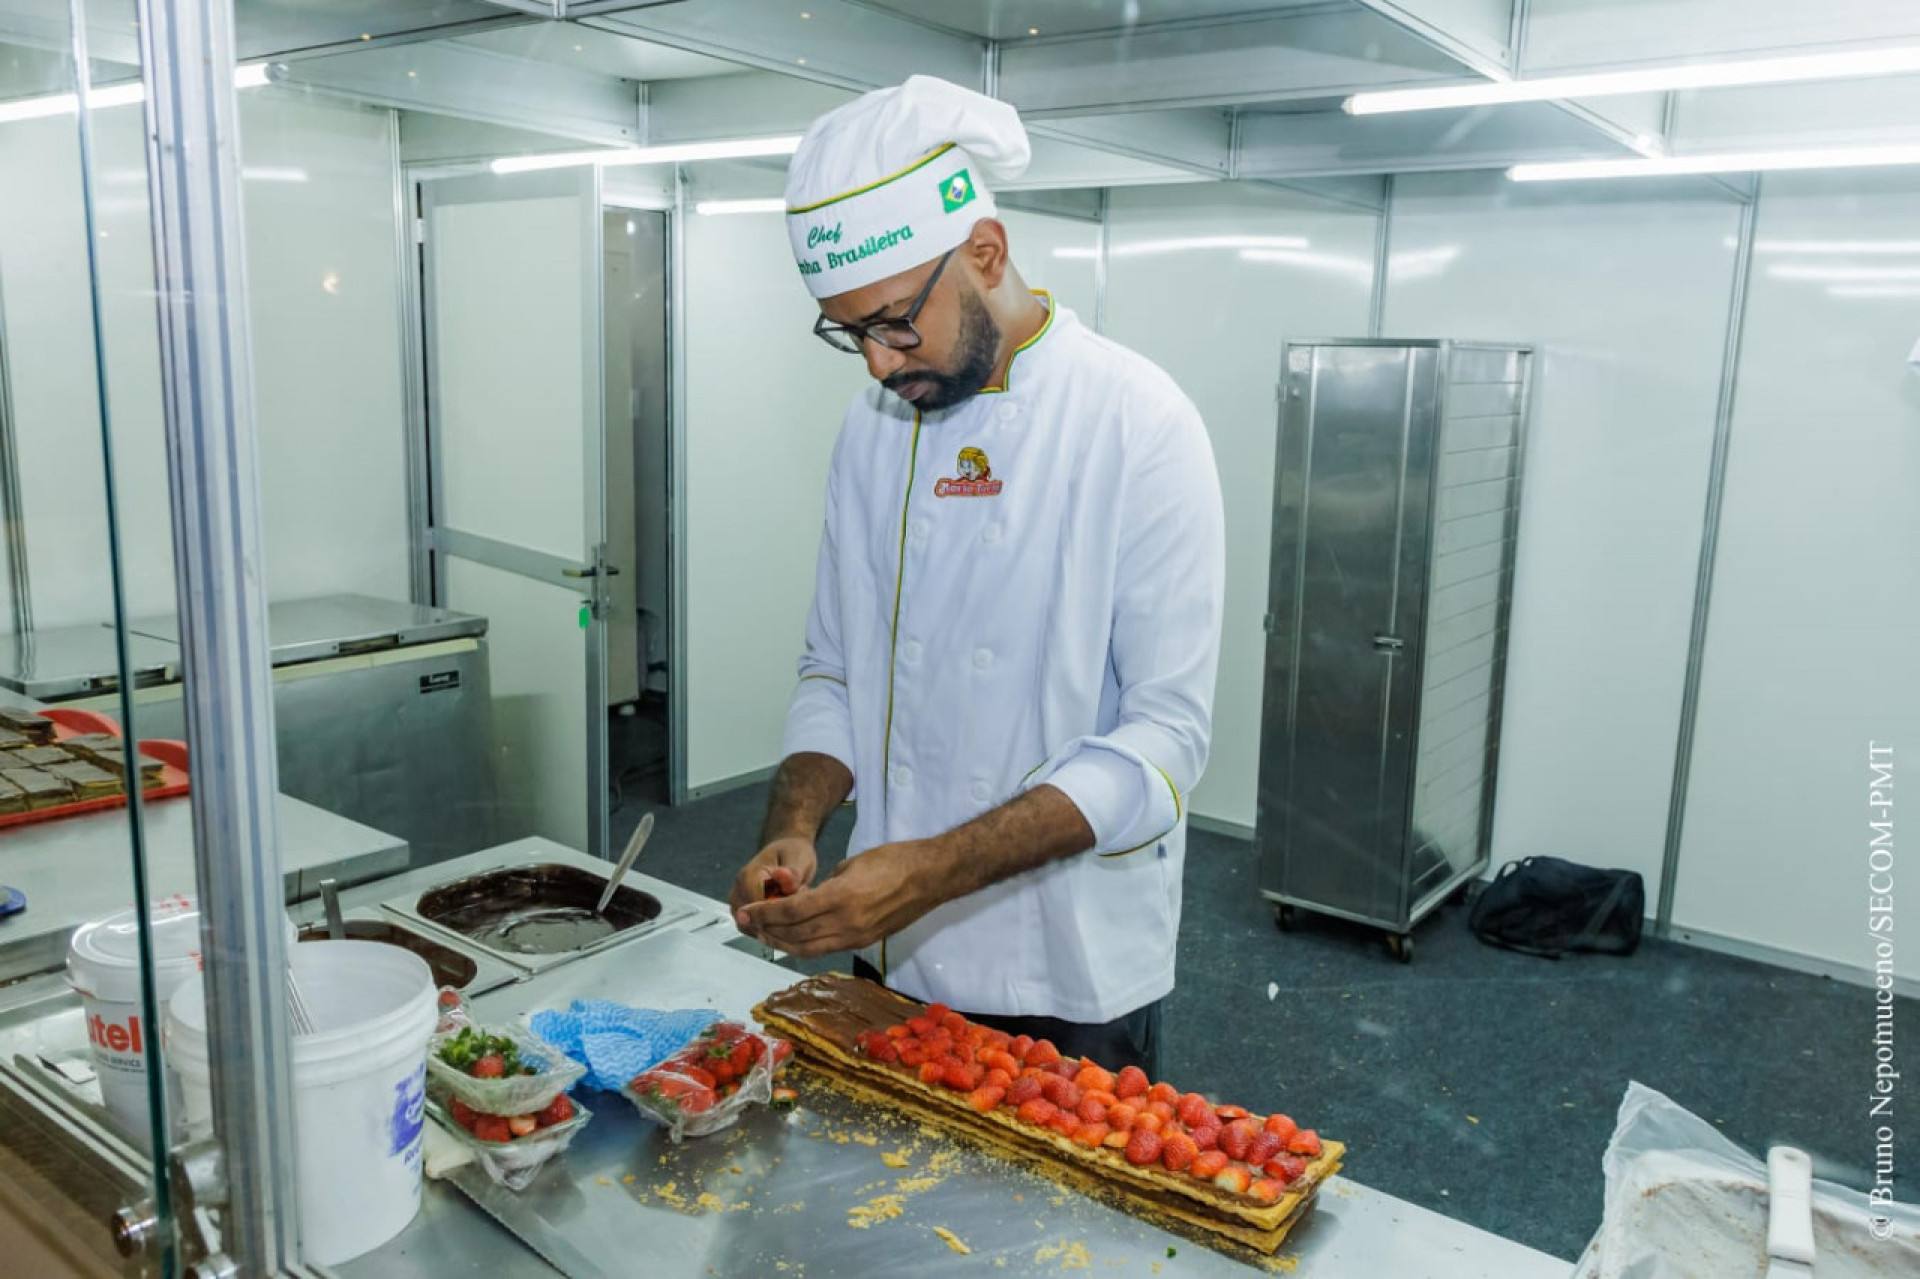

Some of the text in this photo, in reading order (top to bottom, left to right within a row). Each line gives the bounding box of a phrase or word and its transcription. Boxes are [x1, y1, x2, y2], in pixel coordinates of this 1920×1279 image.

[808, 222, 842, 248] Chef
[827, 225, 914, 268] Brasileira
[89, 1014, 143, 1053] utel
